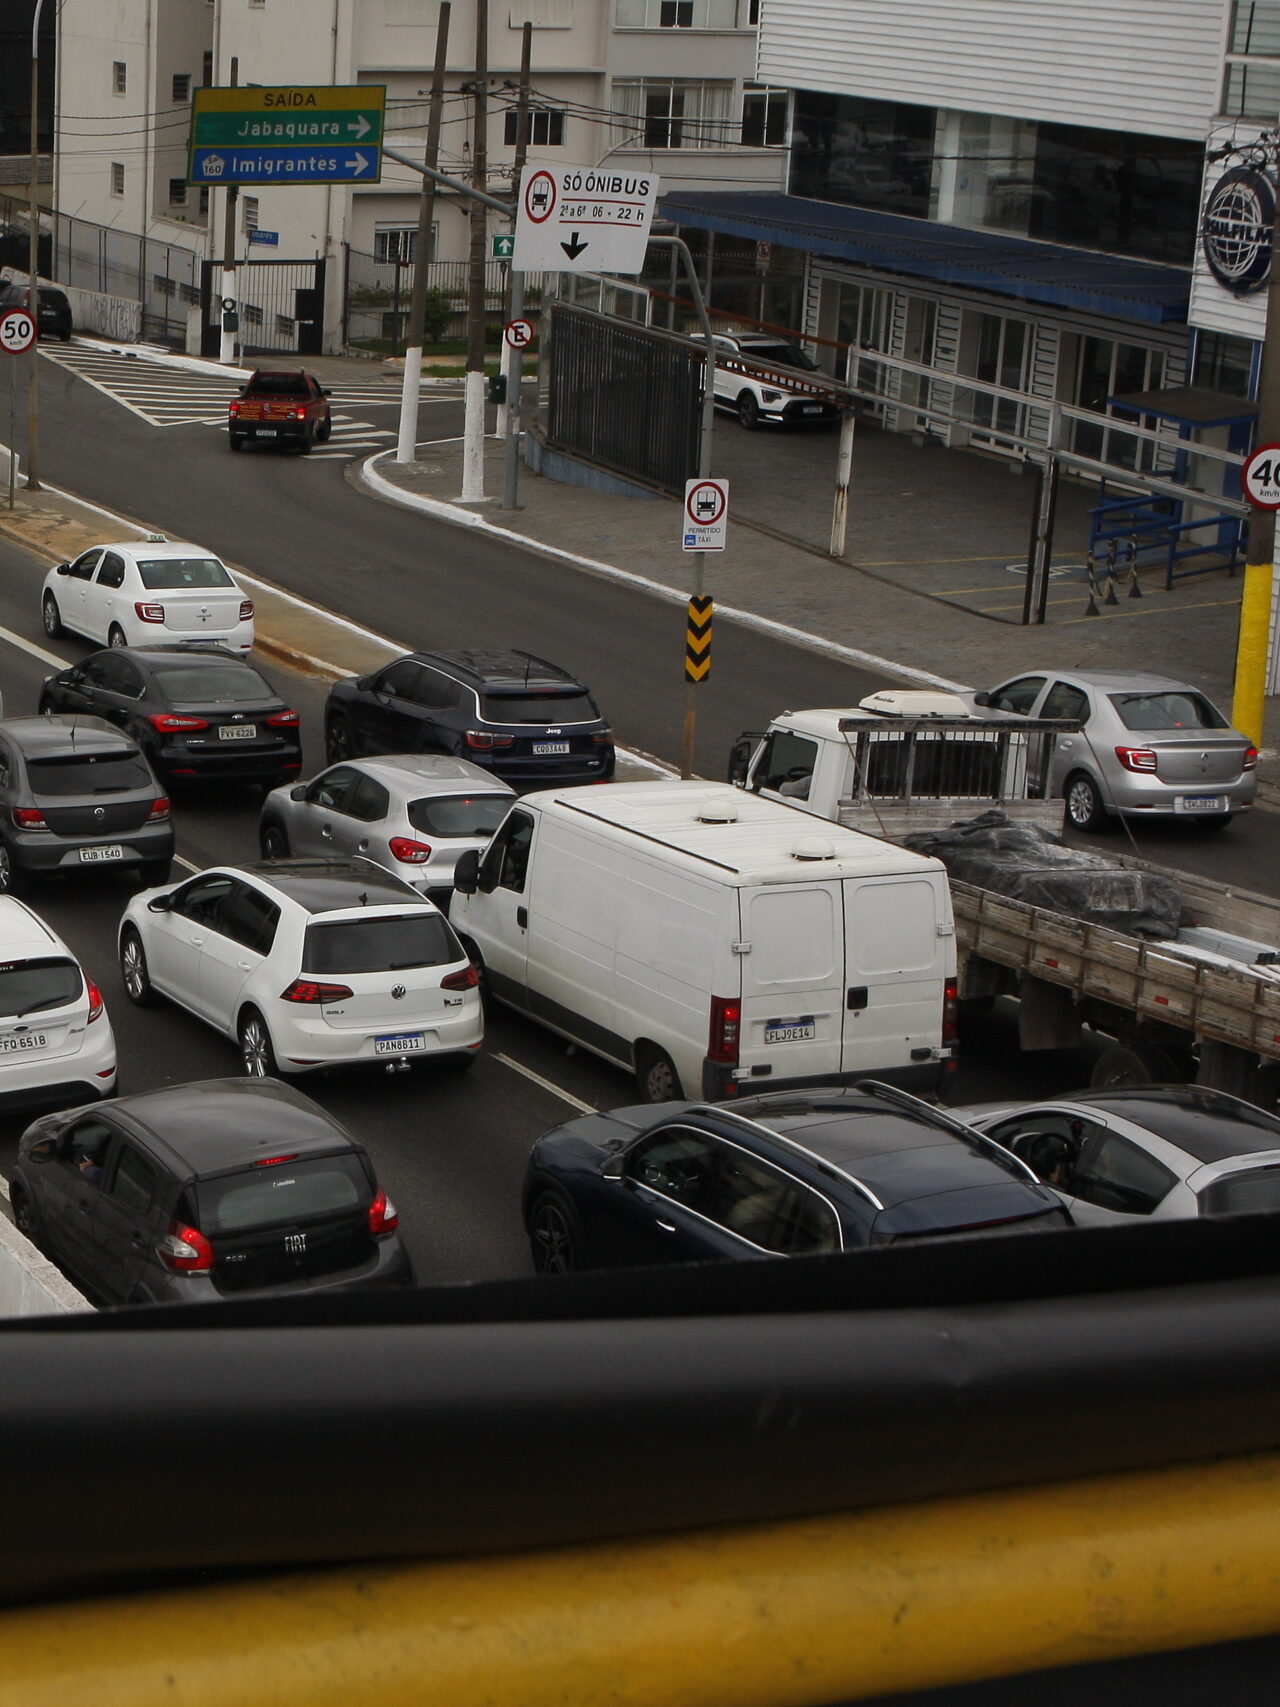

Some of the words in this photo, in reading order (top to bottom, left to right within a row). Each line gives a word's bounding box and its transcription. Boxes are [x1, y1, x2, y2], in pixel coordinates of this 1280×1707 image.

[264, 90, 317, 107] SAÍDA
[238, 121, 340, 138] Jabaquara
[207, 157, 219, 165] SP
[232, 156, 337, 175] Imigrantes
[204, 166, 222, 174] 160
[562, 170, 582, 191] SÓ
[585, 171, 650, 196] ÔNIBUS
[570, 208, 574, 216] a
[592, 206, 604, 218] 06
[617, 208, 632, 220] 22
[636, 209, 644, 222] h
[4, 320, 31, 339] 50
[546, 728, 562, 736] Jeep
[380, 1038, 420, 1052] PAN8B11
[284, 1233, 307, 1253] FIAT
